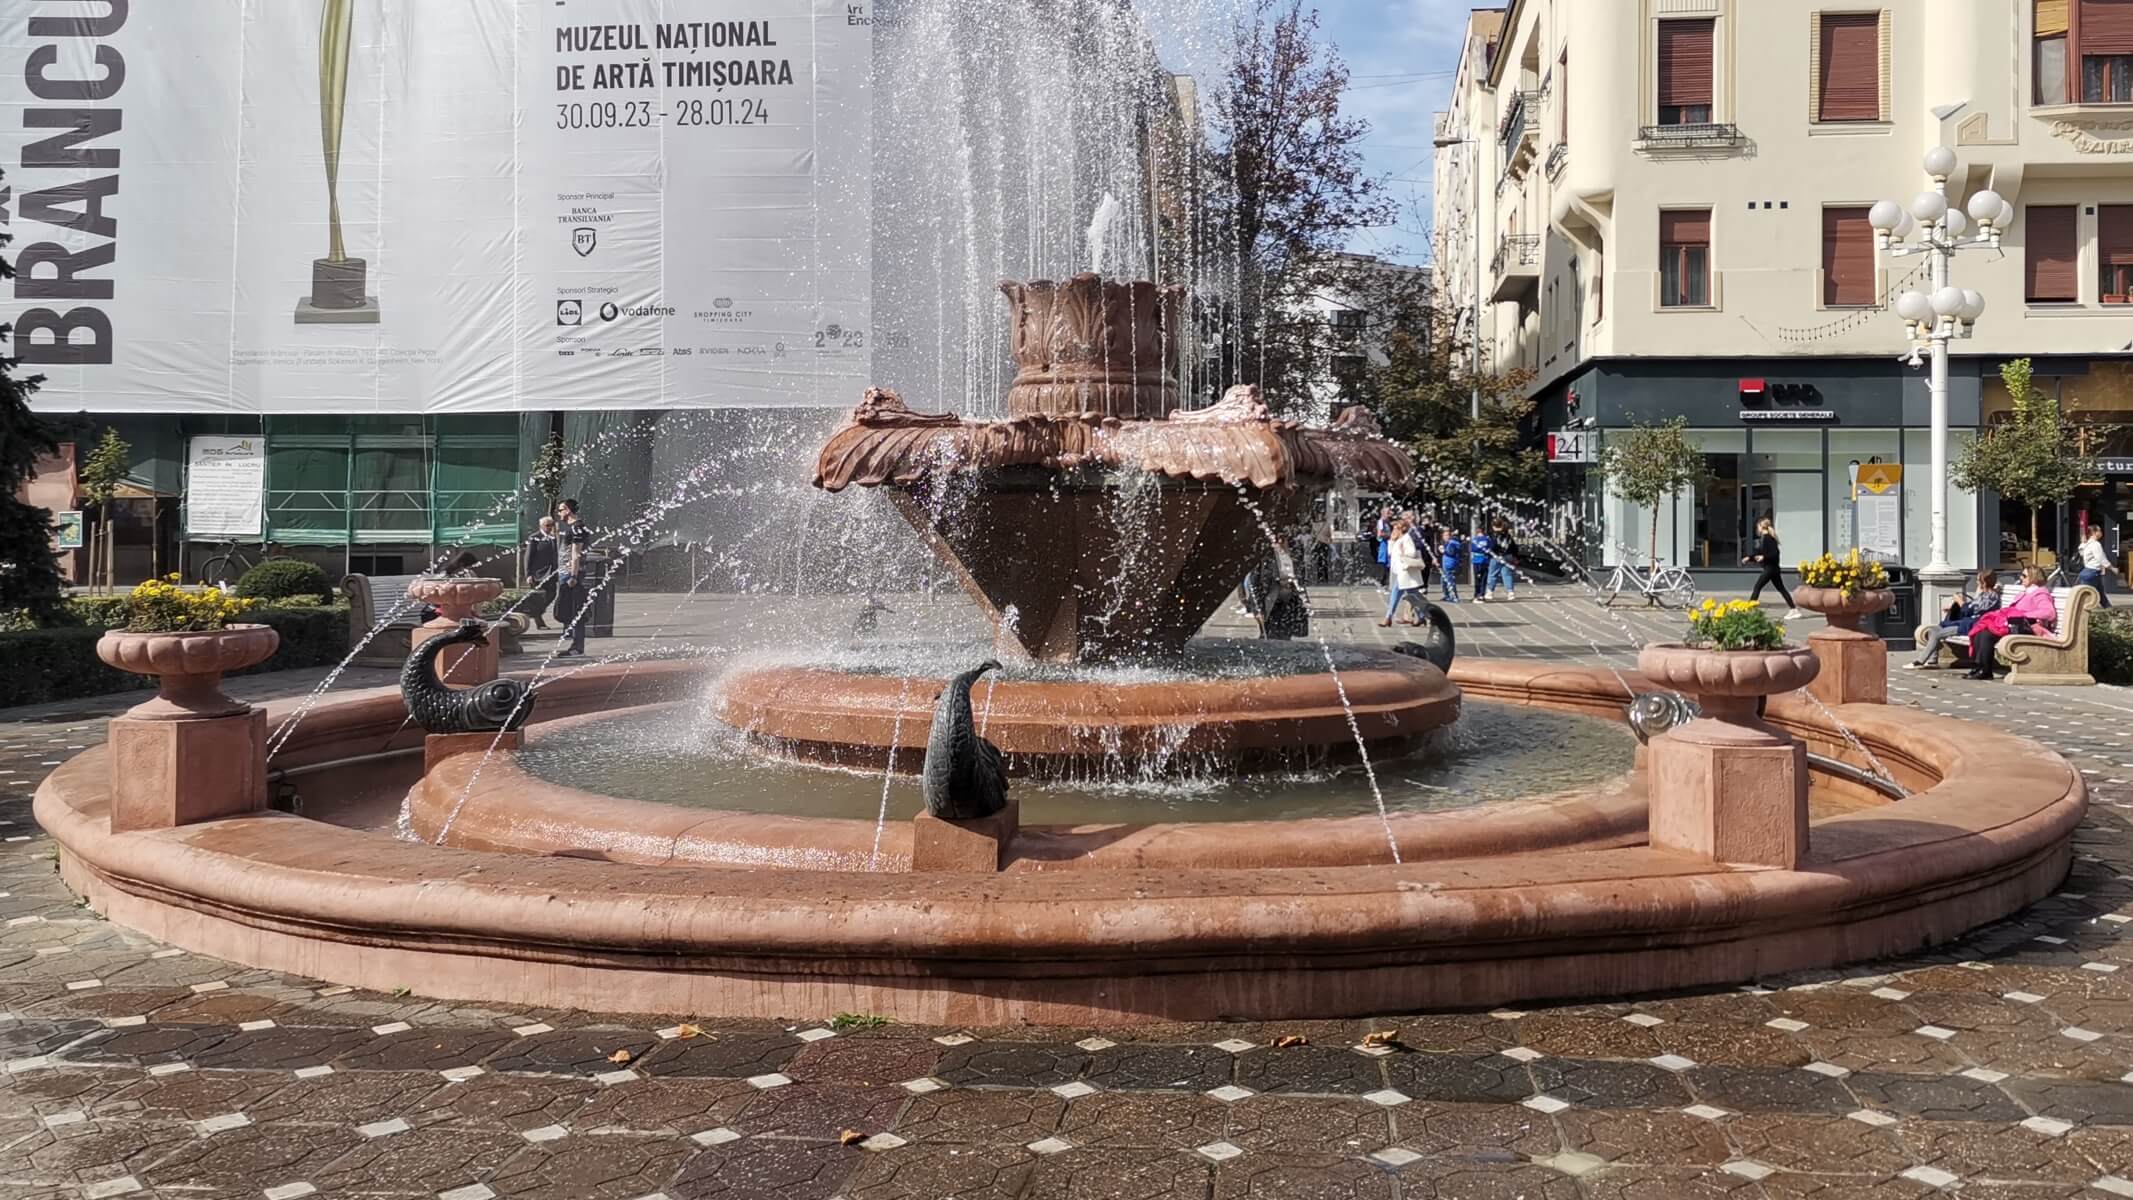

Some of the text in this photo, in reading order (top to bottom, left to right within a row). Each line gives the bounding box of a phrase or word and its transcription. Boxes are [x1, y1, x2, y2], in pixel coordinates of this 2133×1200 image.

[556, 21, 777, 54] MUZEUL NAȚIONAL
[556, 57, 794, 93] DE ARTĂ TIMIȘOARA
[556, 101, 651, 130] 30.09.23
[676, 98, 769, 126] 28.01.24
[557, 192, 615, 201] Sponsor Principal
[558, 215, 612, 224] TRANSILVANIA
[577, 234, 591, 244] BT
[557, 286, 619, 295] Sponsori Strategici
[621, 305, 676, 317] vodafone
